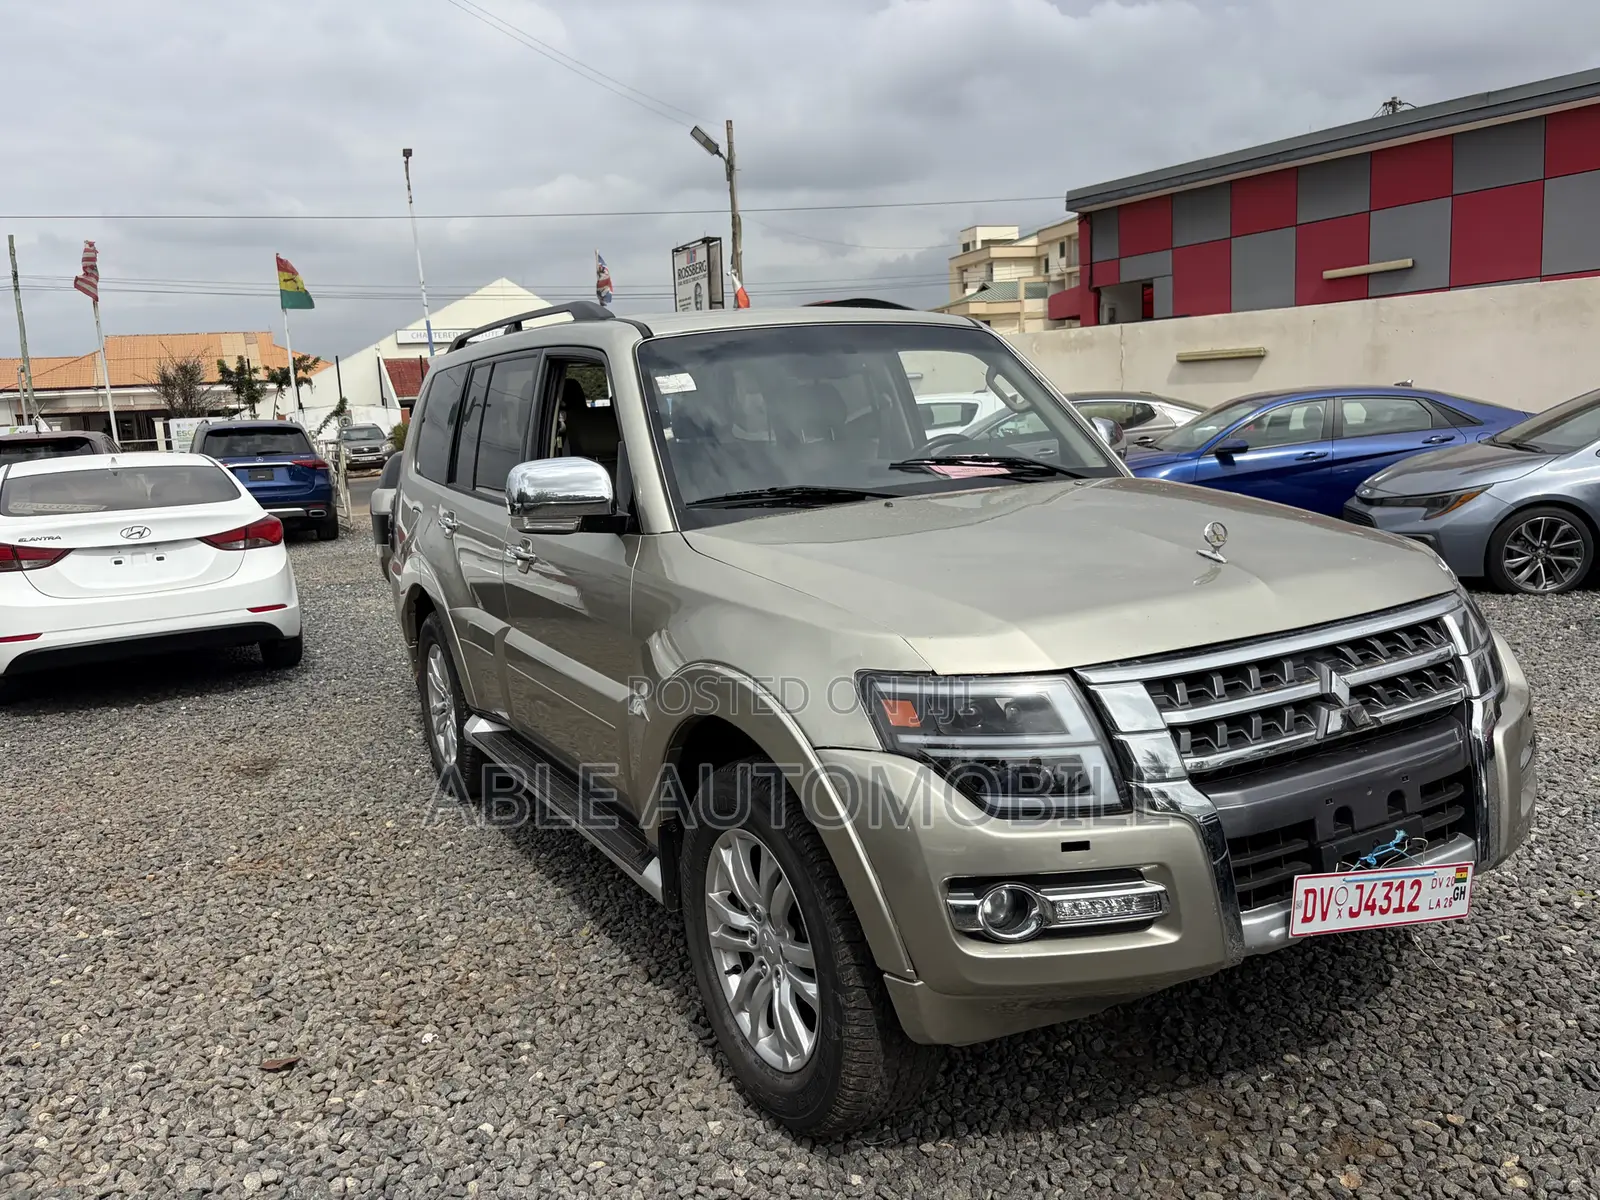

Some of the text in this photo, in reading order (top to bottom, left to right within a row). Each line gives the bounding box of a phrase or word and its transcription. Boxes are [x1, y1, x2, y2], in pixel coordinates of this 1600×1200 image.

[678, 260, 707, 280] ROSSBERG
[411, 331, 459, 340] CHATERED
[1431, 877, 1444, 889] DV
[1453, 886, 1466, 901] GH
[1301, 879, 1422, 923] DV J4312
[1428, 896, 1441, 910] LA
